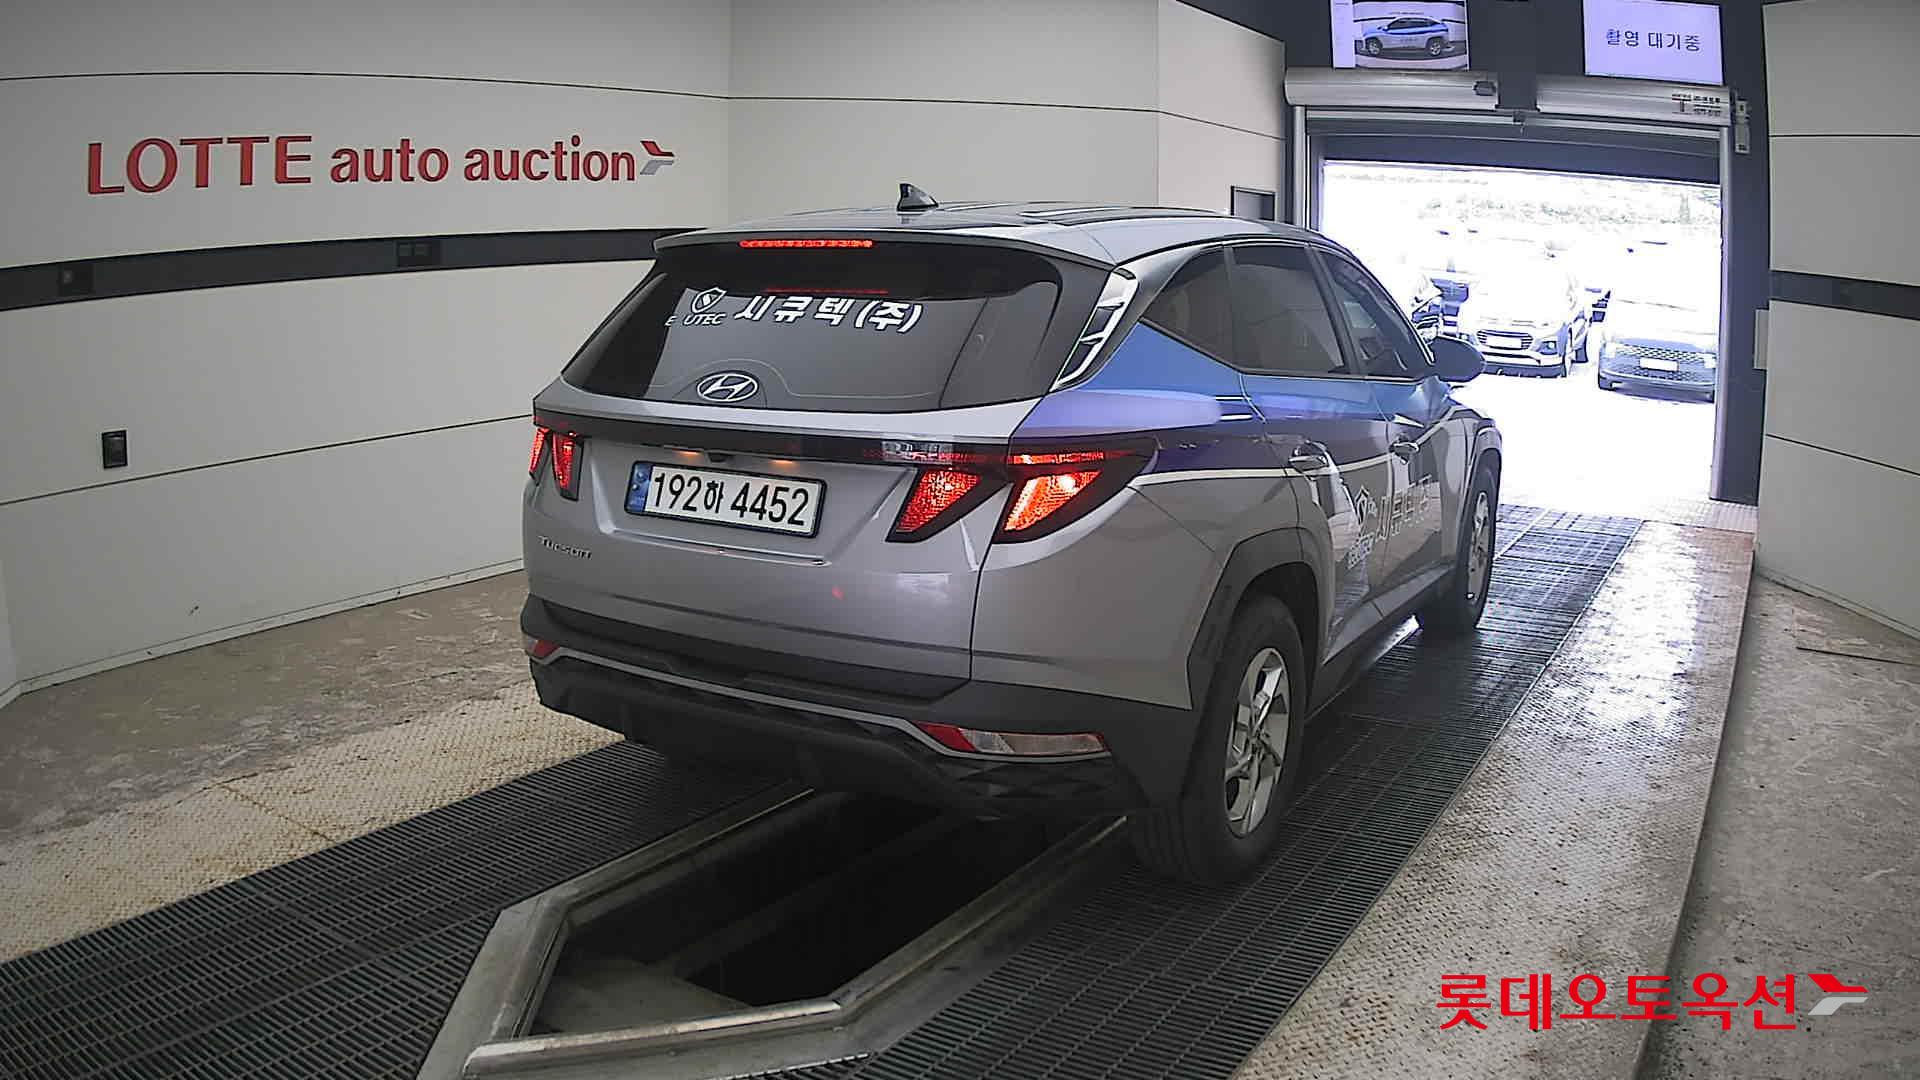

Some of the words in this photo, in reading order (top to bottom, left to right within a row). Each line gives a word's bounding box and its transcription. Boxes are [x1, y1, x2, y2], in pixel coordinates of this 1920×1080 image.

[1648, 31, 1701, 52] 대기중
[88, 135, 312, 195] LOTTE
[330, 138, 449, 183] auto
[464, 134, 635, 181] auction
